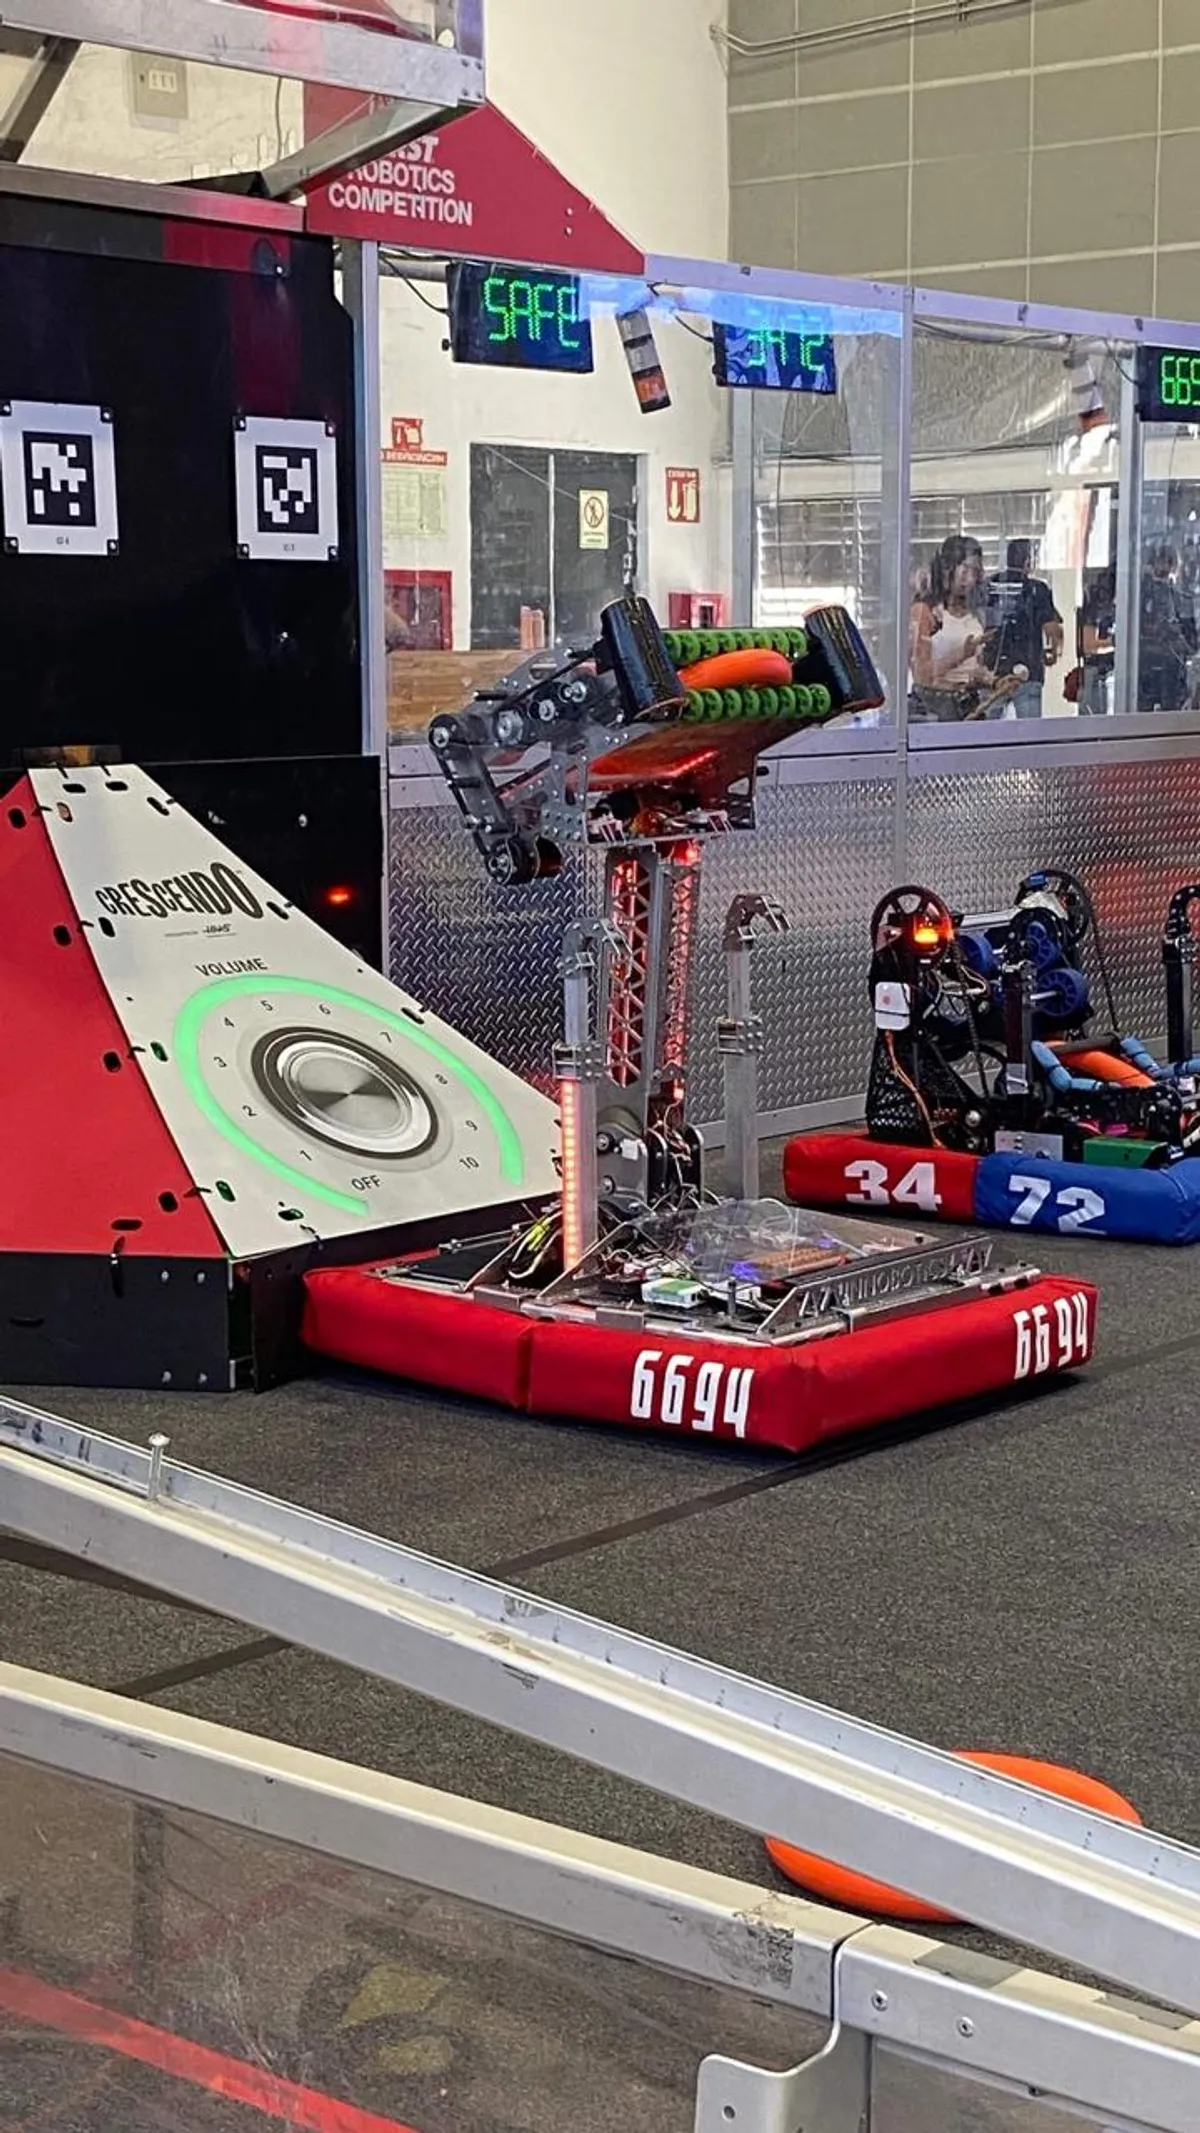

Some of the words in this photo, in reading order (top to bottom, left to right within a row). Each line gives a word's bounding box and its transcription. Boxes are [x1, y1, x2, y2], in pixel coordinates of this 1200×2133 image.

[328, 183, 473, 226] COMPETITION
[484, 276, 580, 348] SAFE
[95, 862, 263, 919] CRESCENDO
[195, 957, 268, 976] VOLUME
[260, 1000, 273, 1011] 5
[318, 1004, 331, 1015] 6
[224, 1016, 235, 1028] 4
[380, 1031, 392, 1043] 7
[213, 1056, 227, 1068] 3
[242, 1104, 257, 1116] 2
[465, 1119, 478, 1131] 9
[300, 1149, 313, 1161] 1
[459, 1156, 480, 1169] 10
[351, 1174, 382, 1191] OFF
[843, 1159, 942, 1211] 34
[1008, 1174, 1108, 1235] 72
[1012, 1291, 1088, 1380] 6694
[630, 1350, 755, 1438] 6694
